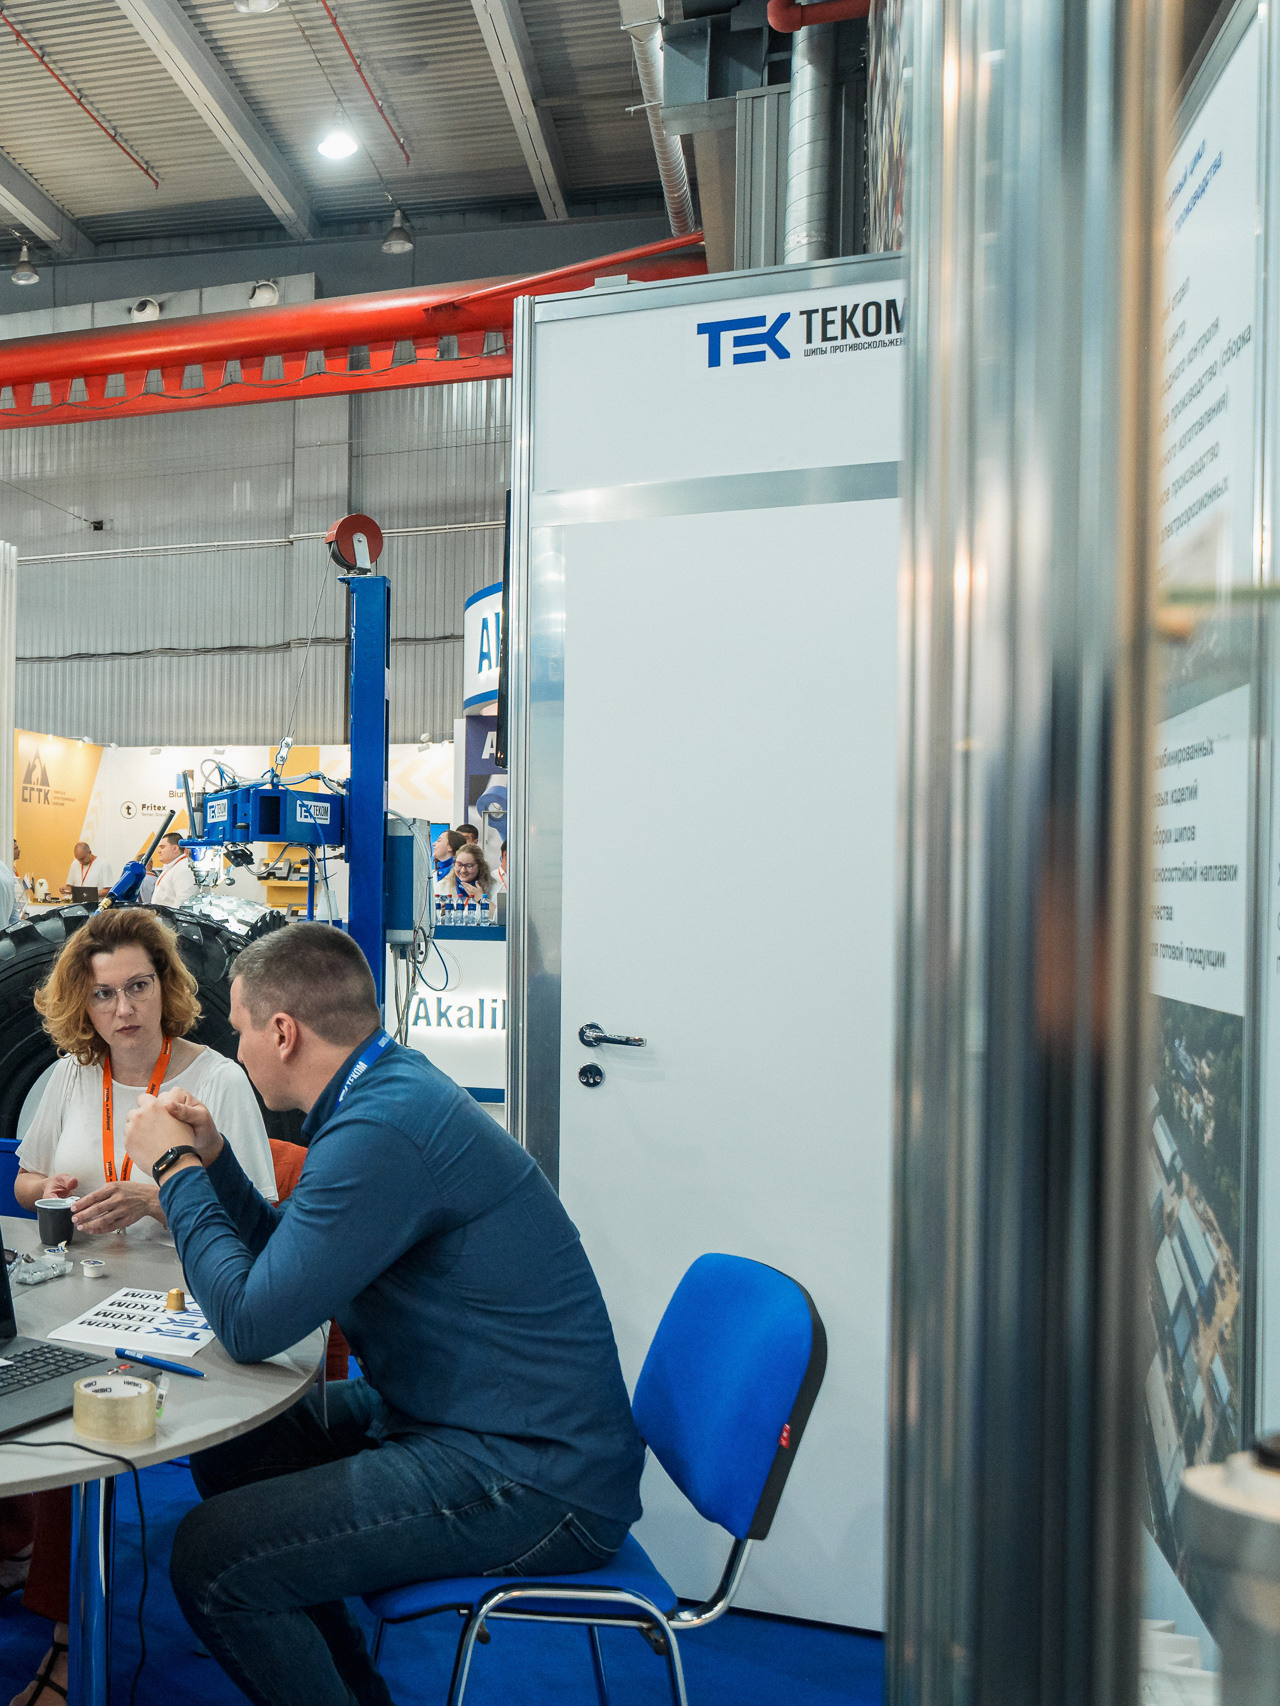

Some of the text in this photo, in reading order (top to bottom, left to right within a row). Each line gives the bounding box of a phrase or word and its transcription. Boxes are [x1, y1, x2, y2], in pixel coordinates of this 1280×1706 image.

[803, 346, 828, 357] ШИПЫ
[141, 803, 167, 811] Fritex
[346, 1061, 368, 1086] ТЕКОМ
[78, 1319, 142, 1334] ТЕКОМ
